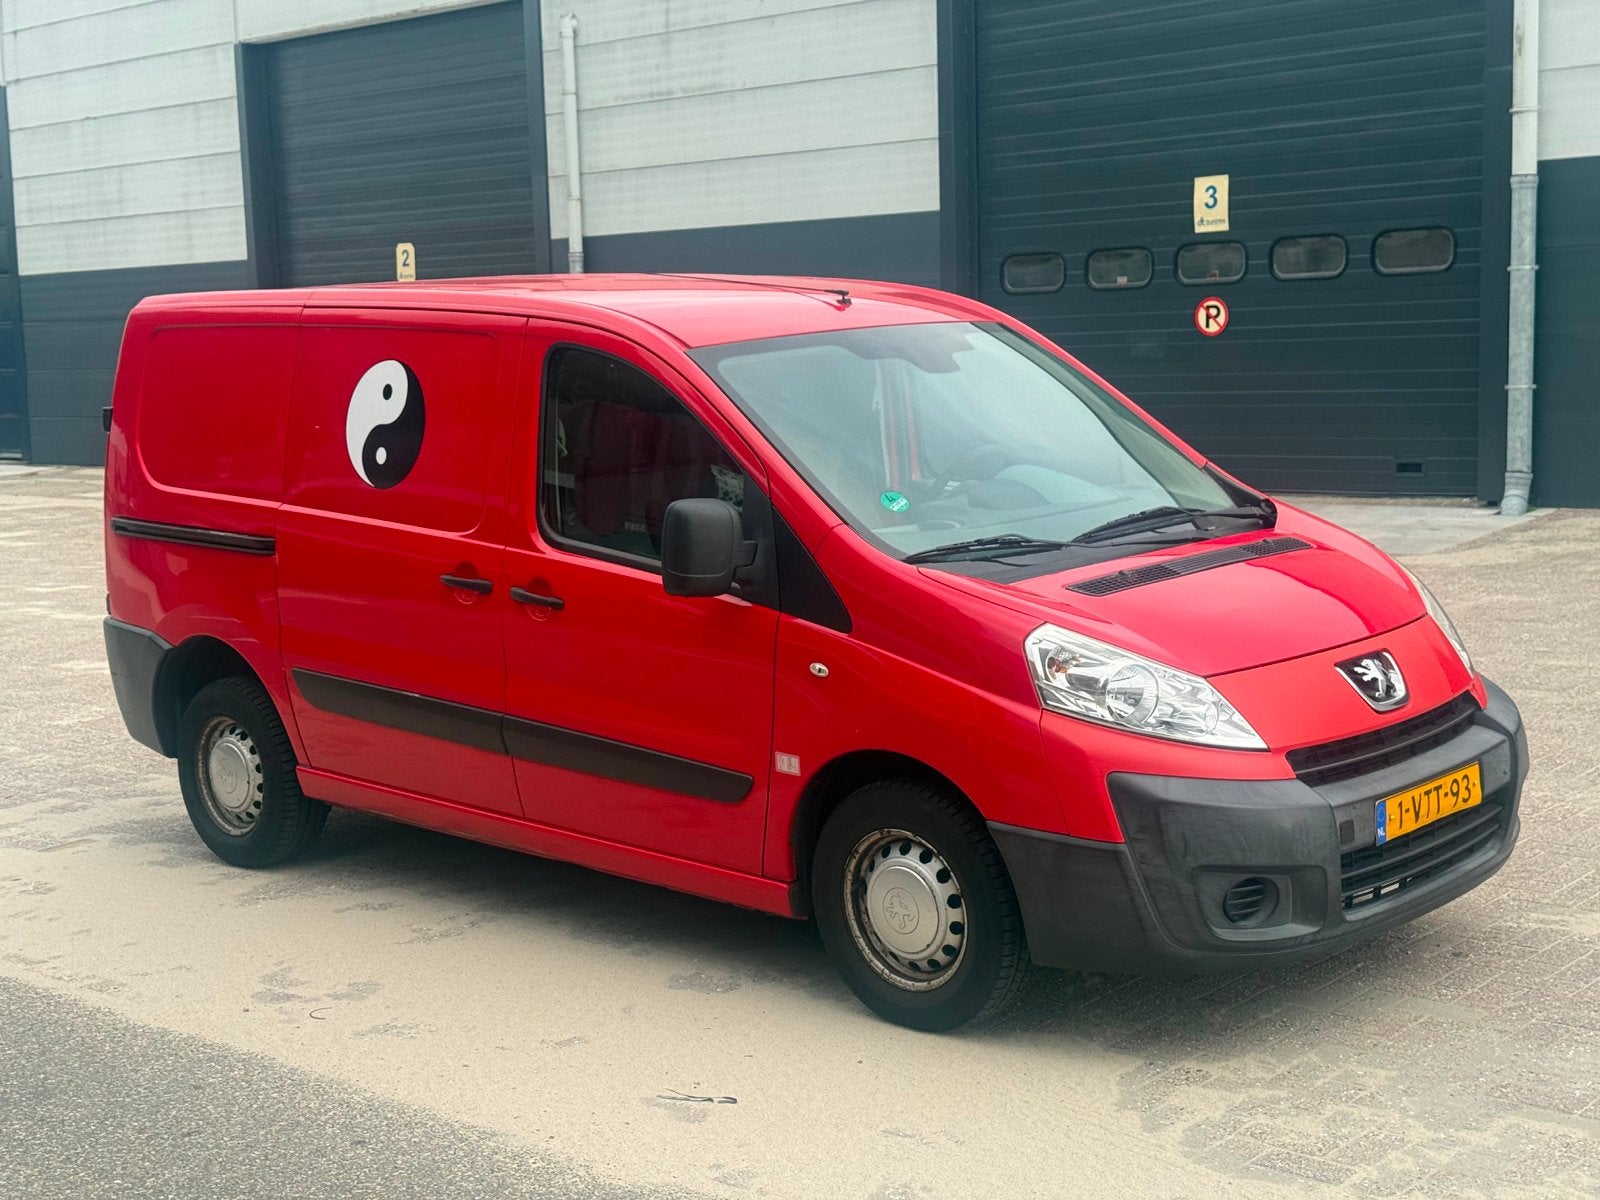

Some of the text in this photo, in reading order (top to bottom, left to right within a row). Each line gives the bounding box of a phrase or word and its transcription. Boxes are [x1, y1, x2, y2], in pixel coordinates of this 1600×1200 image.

[1204, 184, 1218, 209] 3
[402, 249, 410, 267] 2
[1205, 304, 1221, 329] P
[1398, 774, 1472, 830] 1-VTT-93
[1377, 826, 1386, 838] NL
